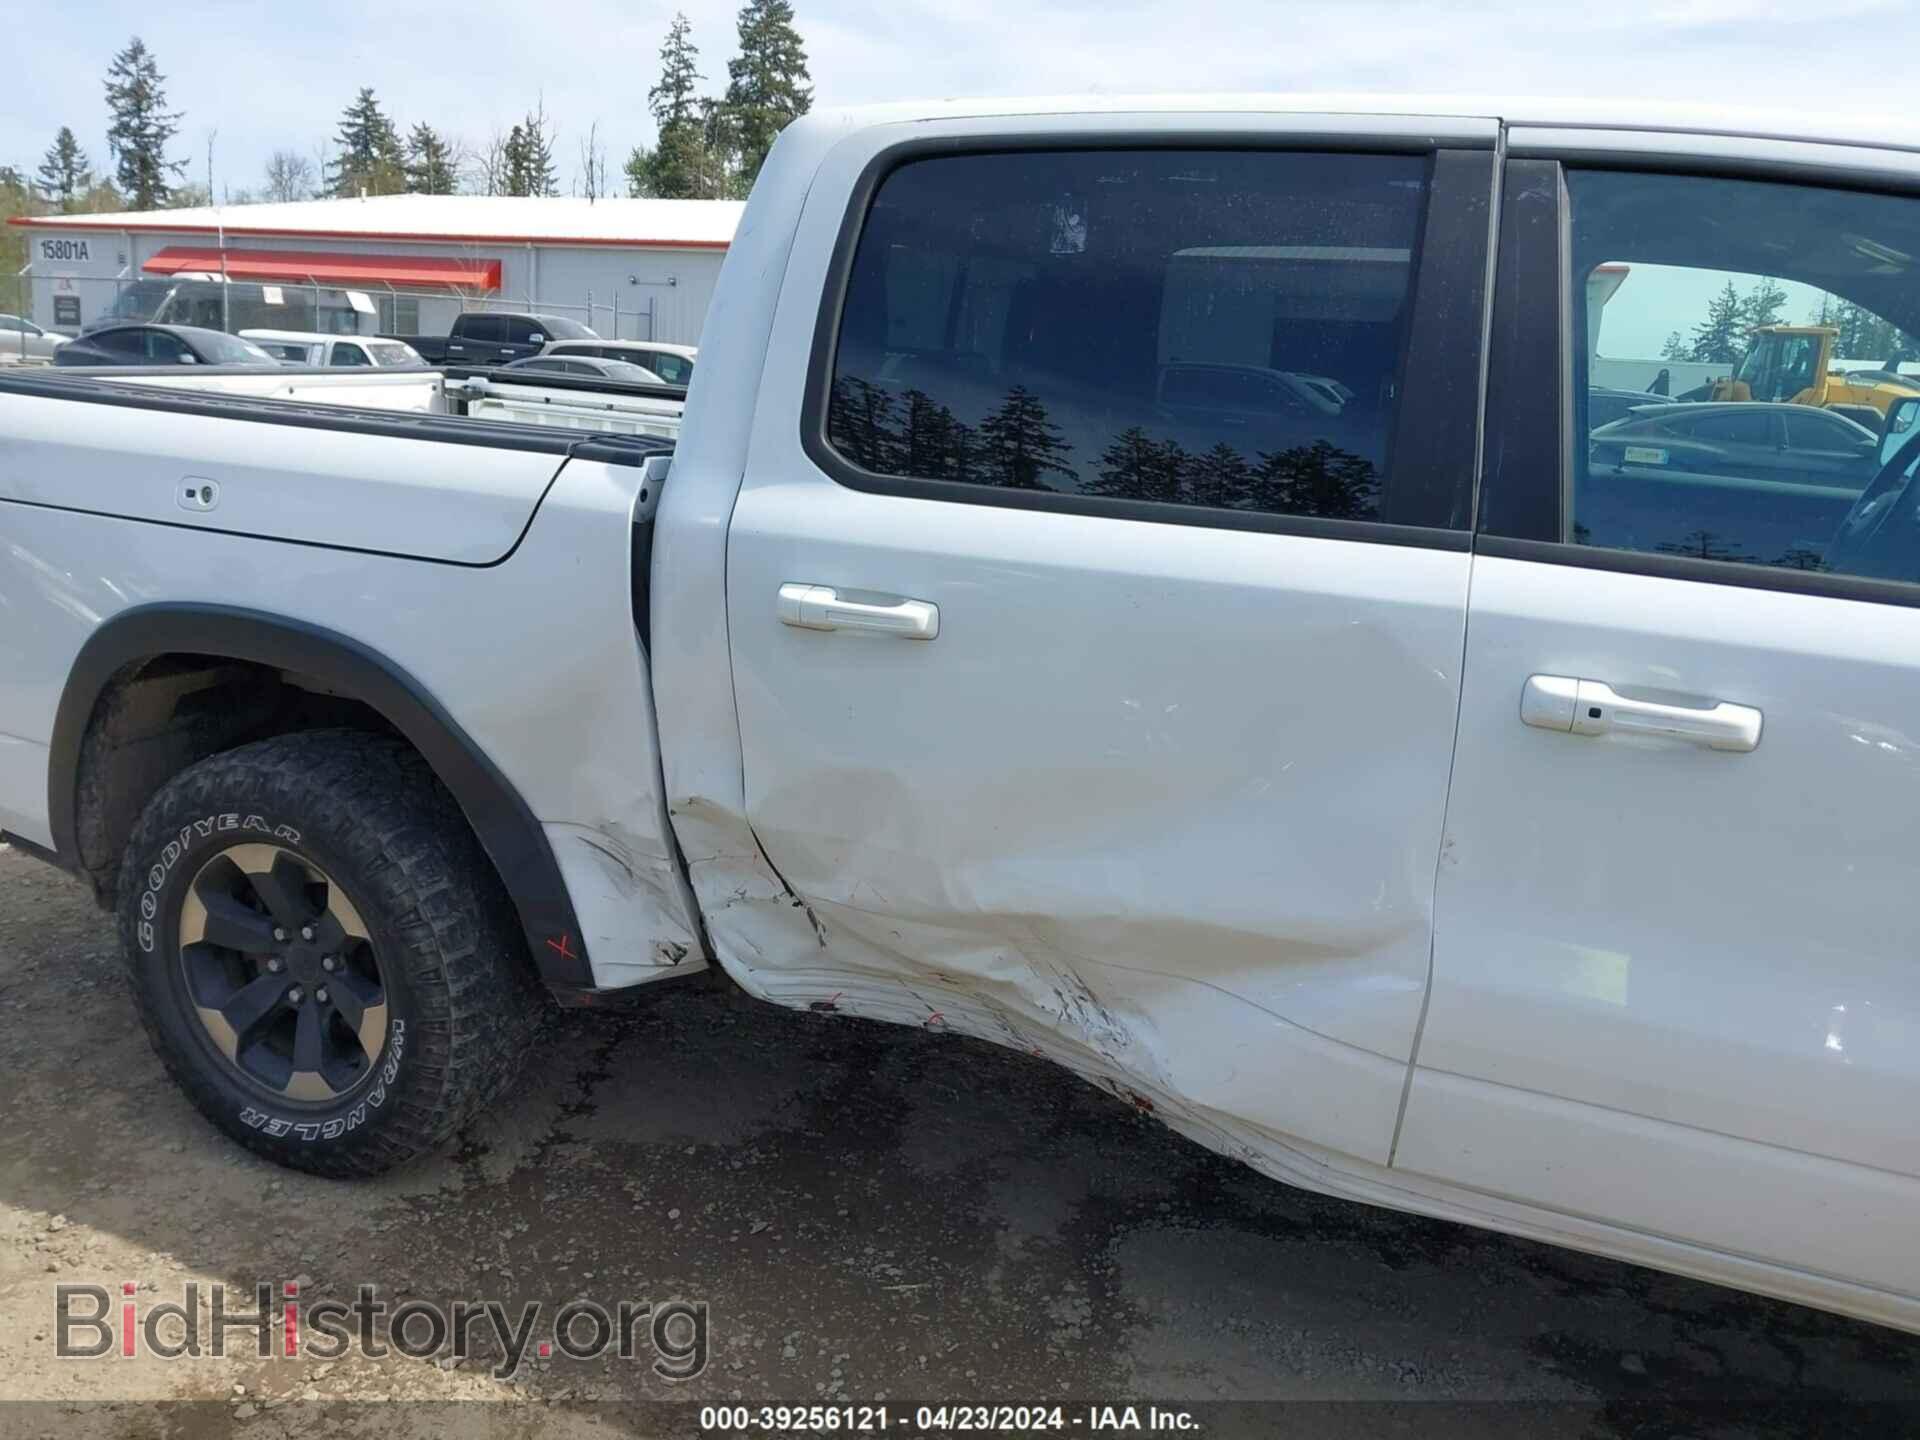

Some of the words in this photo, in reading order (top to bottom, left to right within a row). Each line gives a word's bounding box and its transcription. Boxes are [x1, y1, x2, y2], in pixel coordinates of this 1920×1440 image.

[40, 239, 88, 260] 15801A
[138, 813, 300, 951] GOODYEAR
[239, 1019, 404, 1140] WRANGLER
